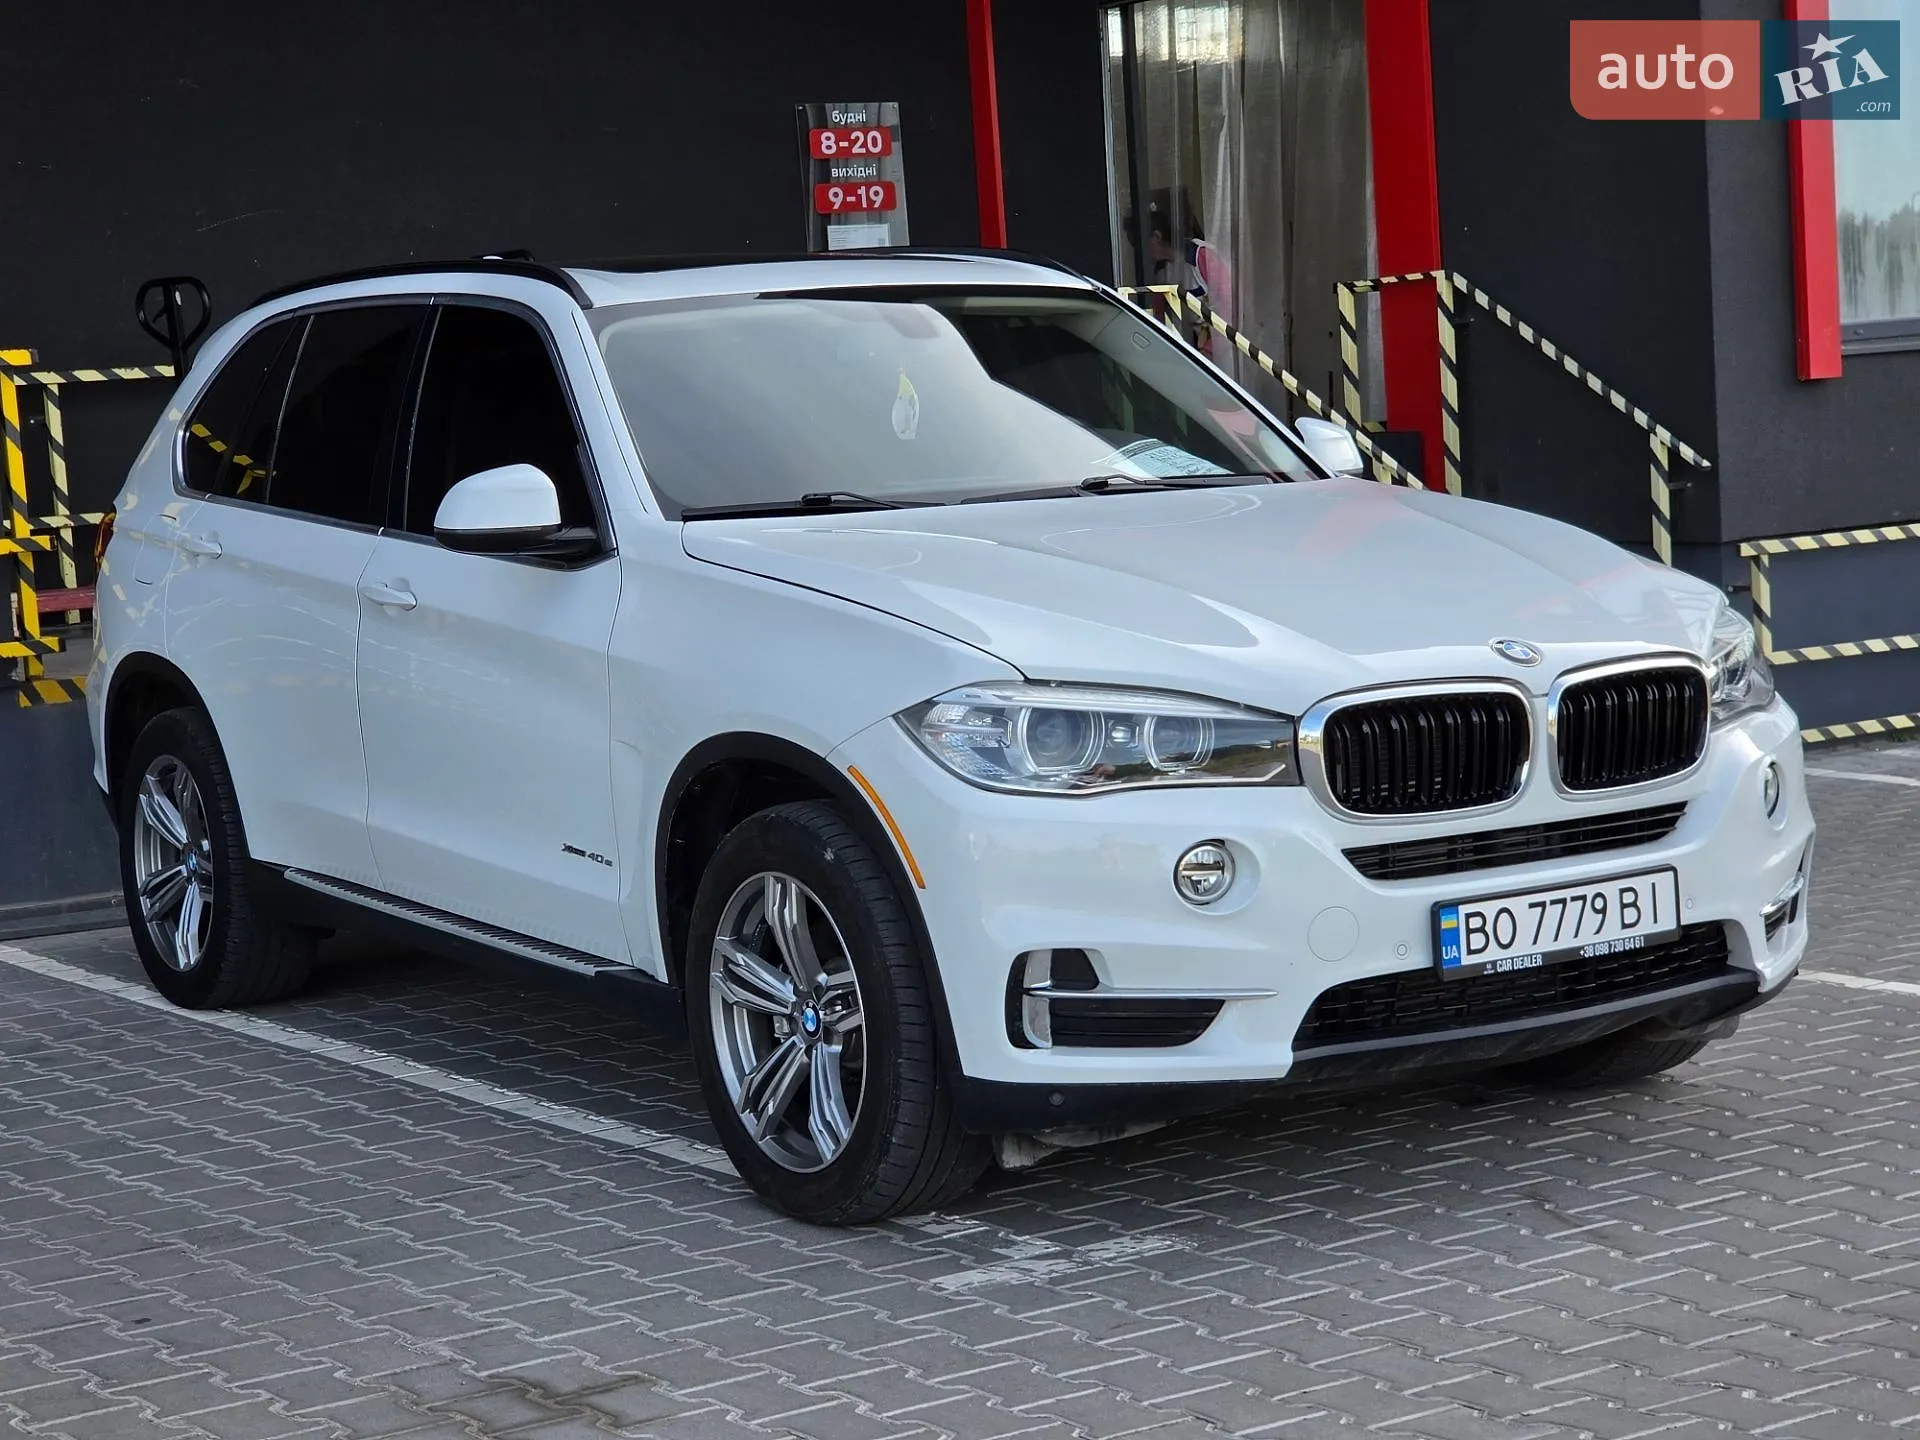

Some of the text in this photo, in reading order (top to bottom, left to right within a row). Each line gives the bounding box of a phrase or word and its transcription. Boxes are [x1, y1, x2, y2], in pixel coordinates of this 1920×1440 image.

[832, 110, 866, 124] будні
[820, 130, 882, 155] 8-20
[831, 164, 877, 178] вихідні
[828, 185, 884, 210] 9-19
[1464, 882, 1658, 956] BO 7779 BI
[1442, 945, 1459, 960] UA
[1579, 945, 1594, 958] +38
[1496, 959, 1512, 972] CAR
[1513, 954, 1542, 970] DEALER
